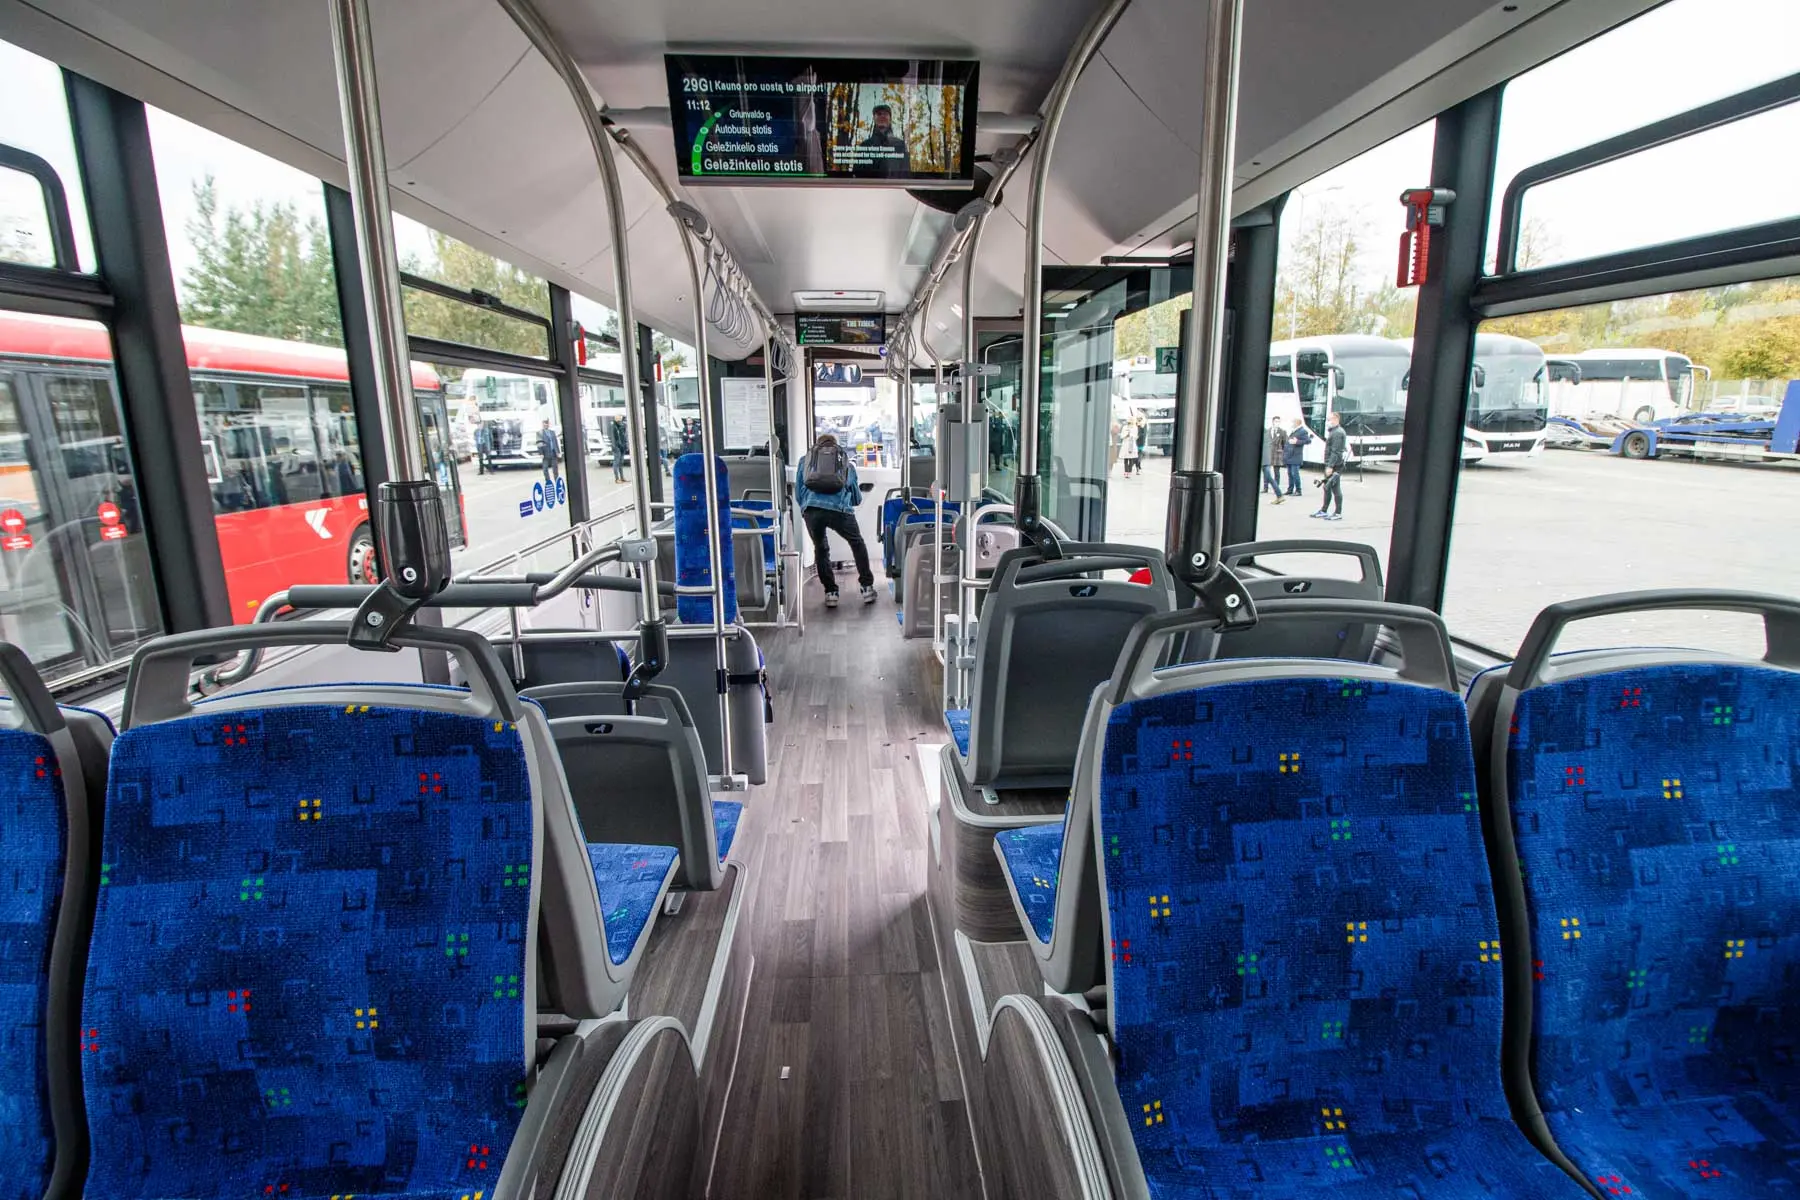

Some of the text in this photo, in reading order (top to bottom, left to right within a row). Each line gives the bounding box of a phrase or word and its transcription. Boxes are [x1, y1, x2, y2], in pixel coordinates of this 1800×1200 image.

[683, 78, 709, 92] 29G
[714, 80, 741, 91] Kauno
[743, 82, 758, 92] oro
[760, 81, 784, 94] uostą
[785, 81, 794, 92] to
[796, 82, 824, 94] airport
[686, 100, 711, 111] 11:12
[715, 123, 773, 136] Autobusų stotis
[705, 141, 779, 153] Geležinkelio stotis
[704, 158, 803, 171] Geležinkelio stotis
